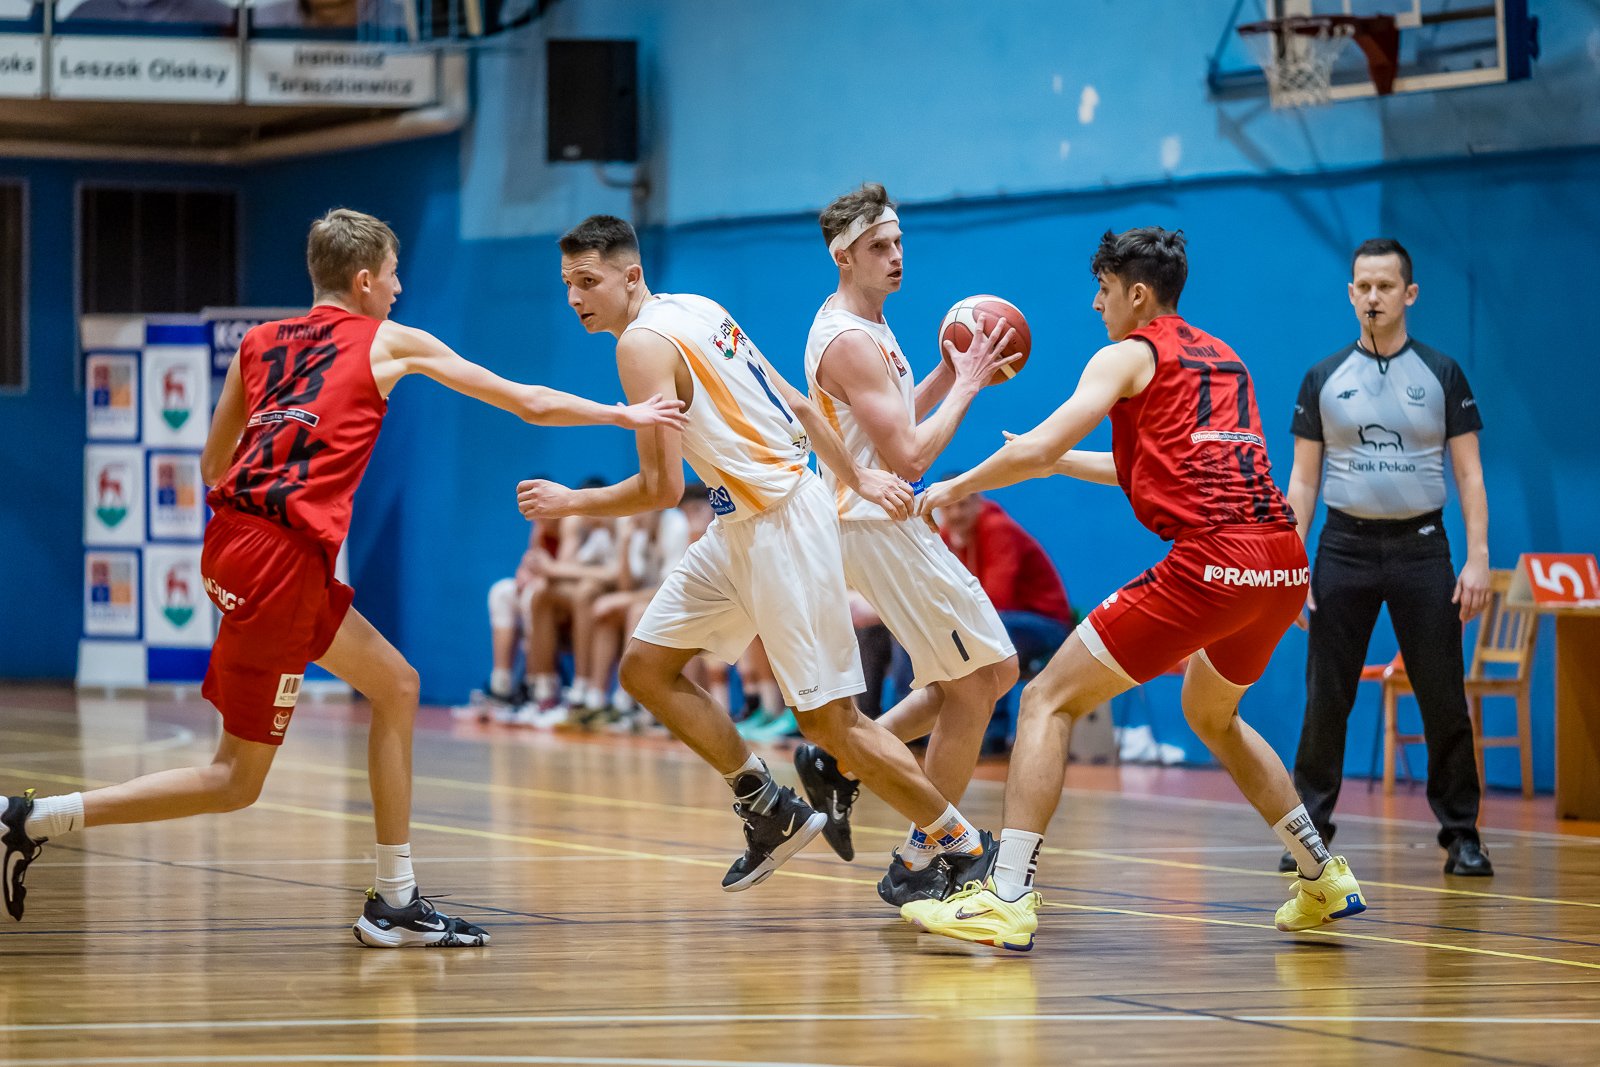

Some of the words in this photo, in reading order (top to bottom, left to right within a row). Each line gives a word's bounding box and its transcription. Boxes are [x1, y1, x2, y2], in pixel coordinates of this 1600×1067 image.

[60, 56, 141, 79] Leszek
[149, 58, 229, 87] Oleksy
[1178, 354, 1249, 429] 77
[1348, 459, 1376, 472] Bank
[1379, 461, 1416, 473] Pekao
